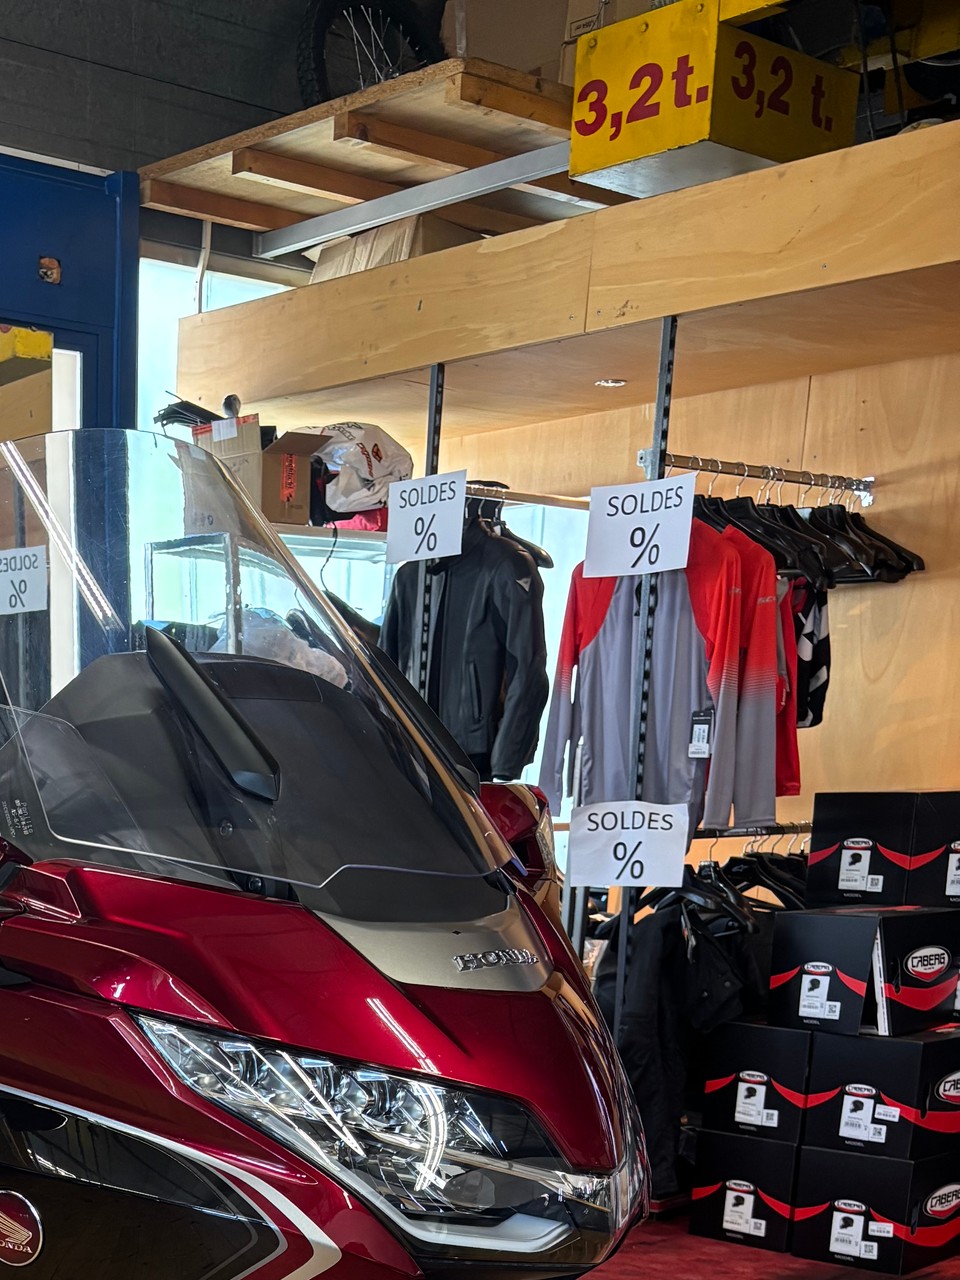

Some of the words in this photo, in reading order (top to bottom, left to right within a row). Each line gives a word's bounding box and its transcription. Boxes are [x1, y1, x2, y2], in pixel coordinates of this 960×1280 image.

[399, 480, 457, 509] SOLDES
[606, 485, 684, 517] SOLDES
[414, 513, 438, 555] %
[629, 523, 661, 568] %
[587, 811, 674, 832] SOLDES
[613, 841, 644, 880] %
[452, 948, 539, 973] HONDA
[911, 952, 946, 968] CABERG
